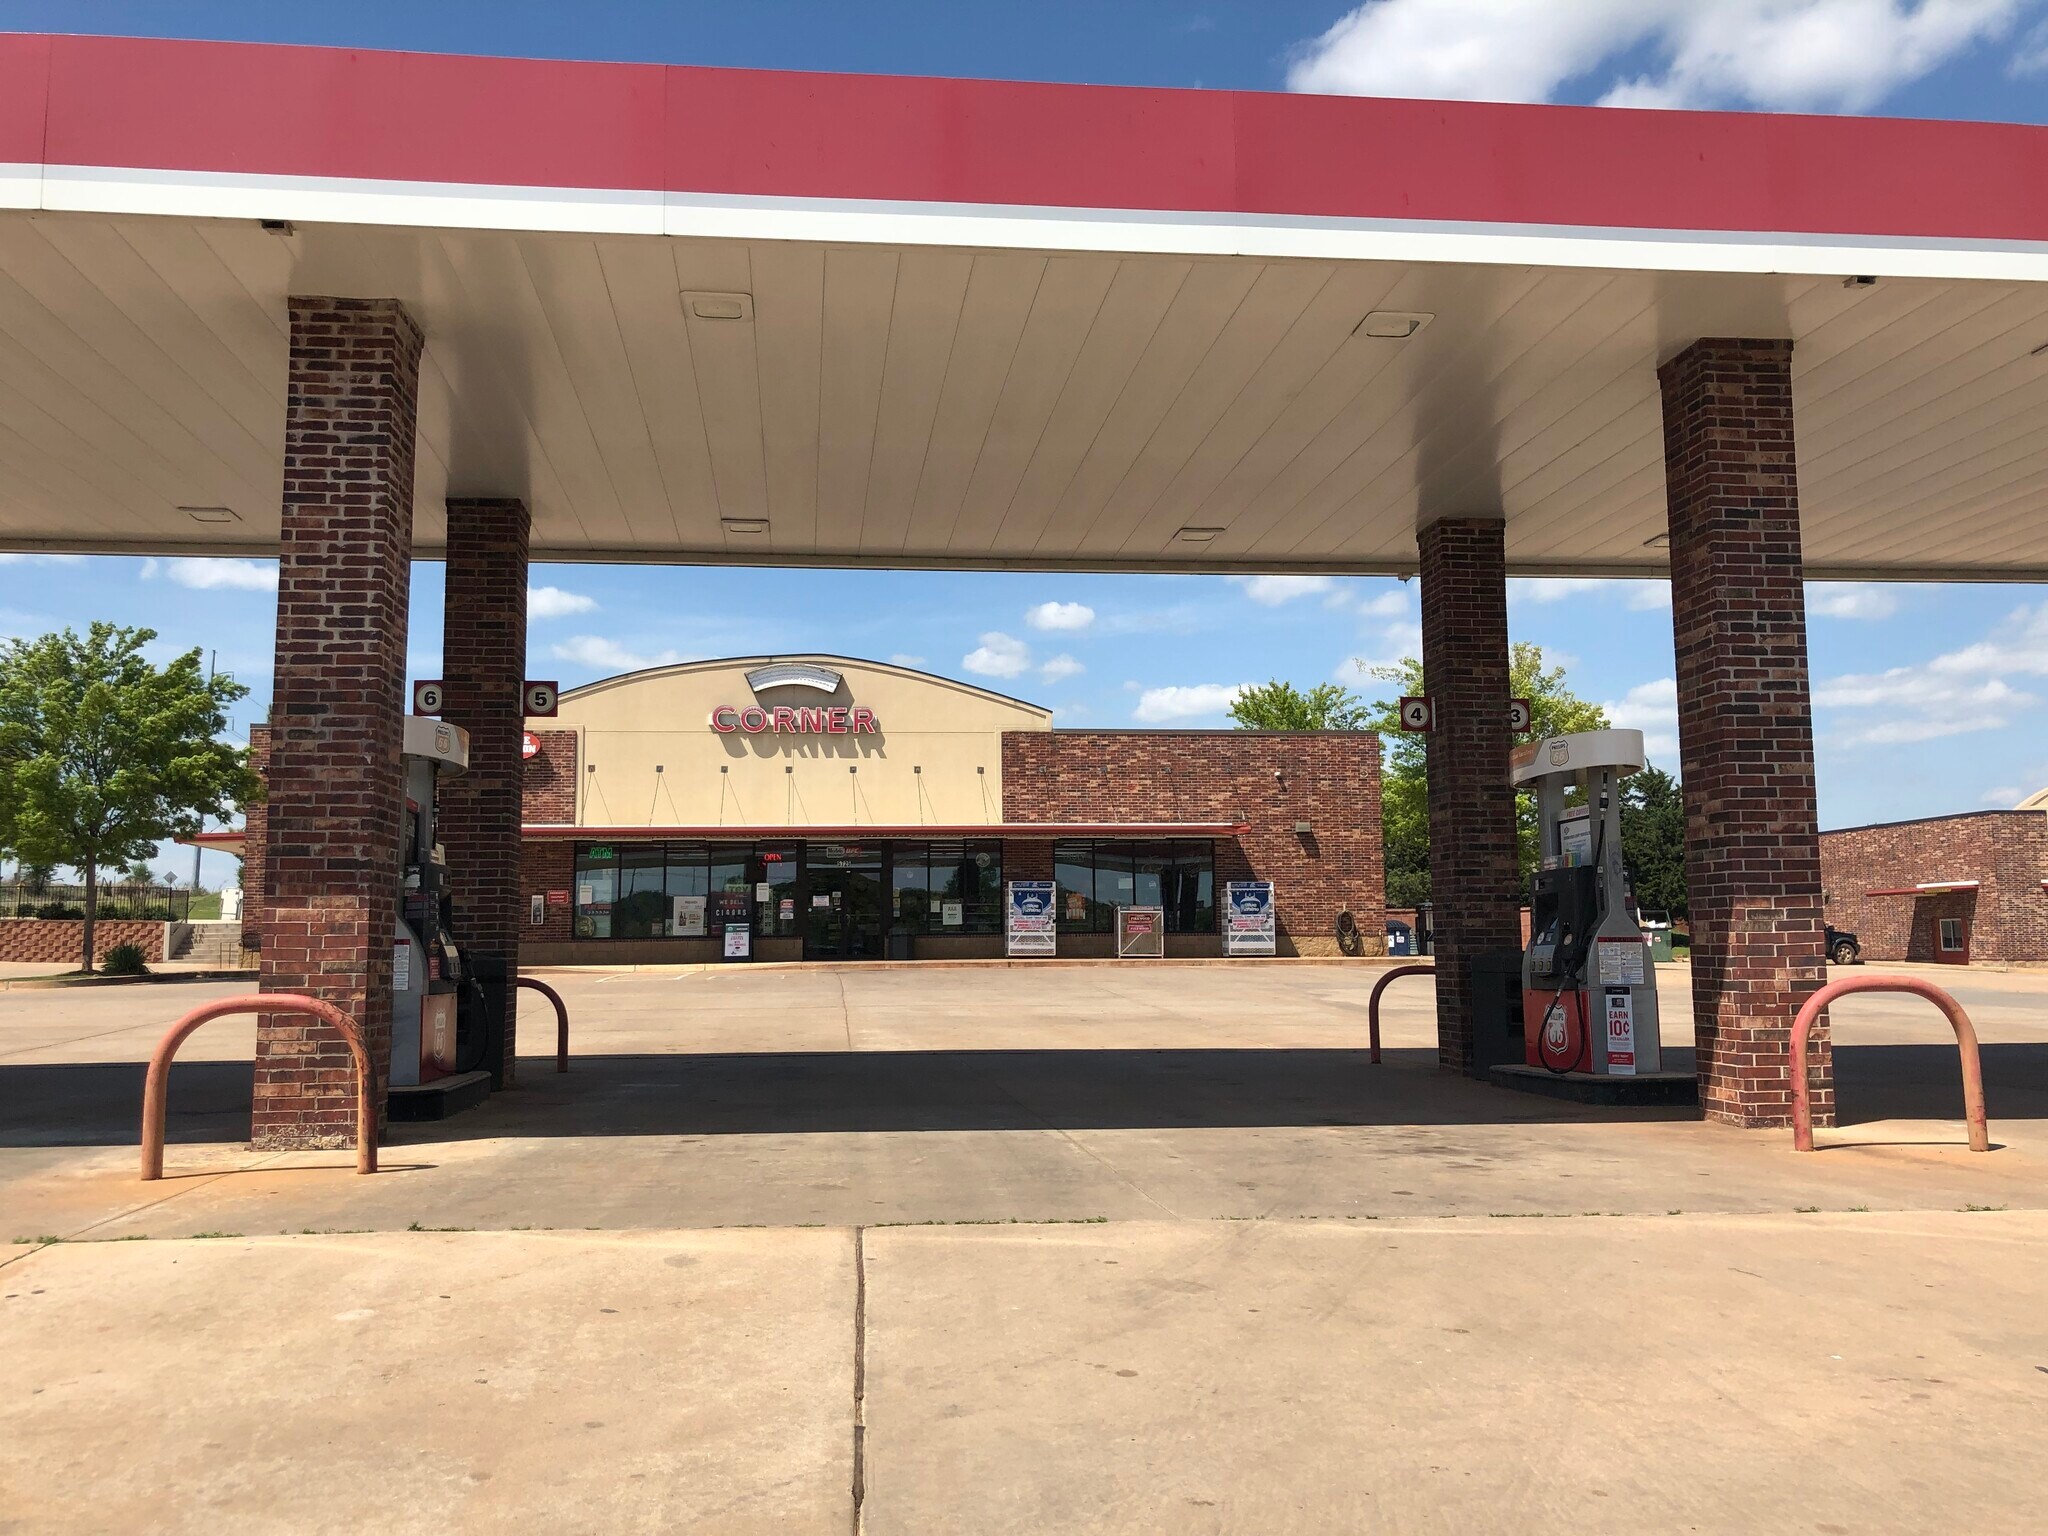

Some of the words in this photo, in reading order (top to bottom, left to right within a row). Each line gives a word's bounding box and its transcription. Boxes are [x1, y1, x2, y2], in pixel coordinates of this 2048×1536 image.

[424, 691, 437, 706] 6
[534, 692, 547, 707] 5
[712, 705, 875, 733] CORNER
[1410, 707, 1423, 721] 4
[1511, 709, 1521, 723] 3
[589, 847, 613, 859] ATM
[764, 853, 782, 861] OPEN
[1608, 1010, 1629, 1020] EARN
[1550, 1022, 1564, 1044] 66
[1609, 1019, 1630, 1036] 10¢
